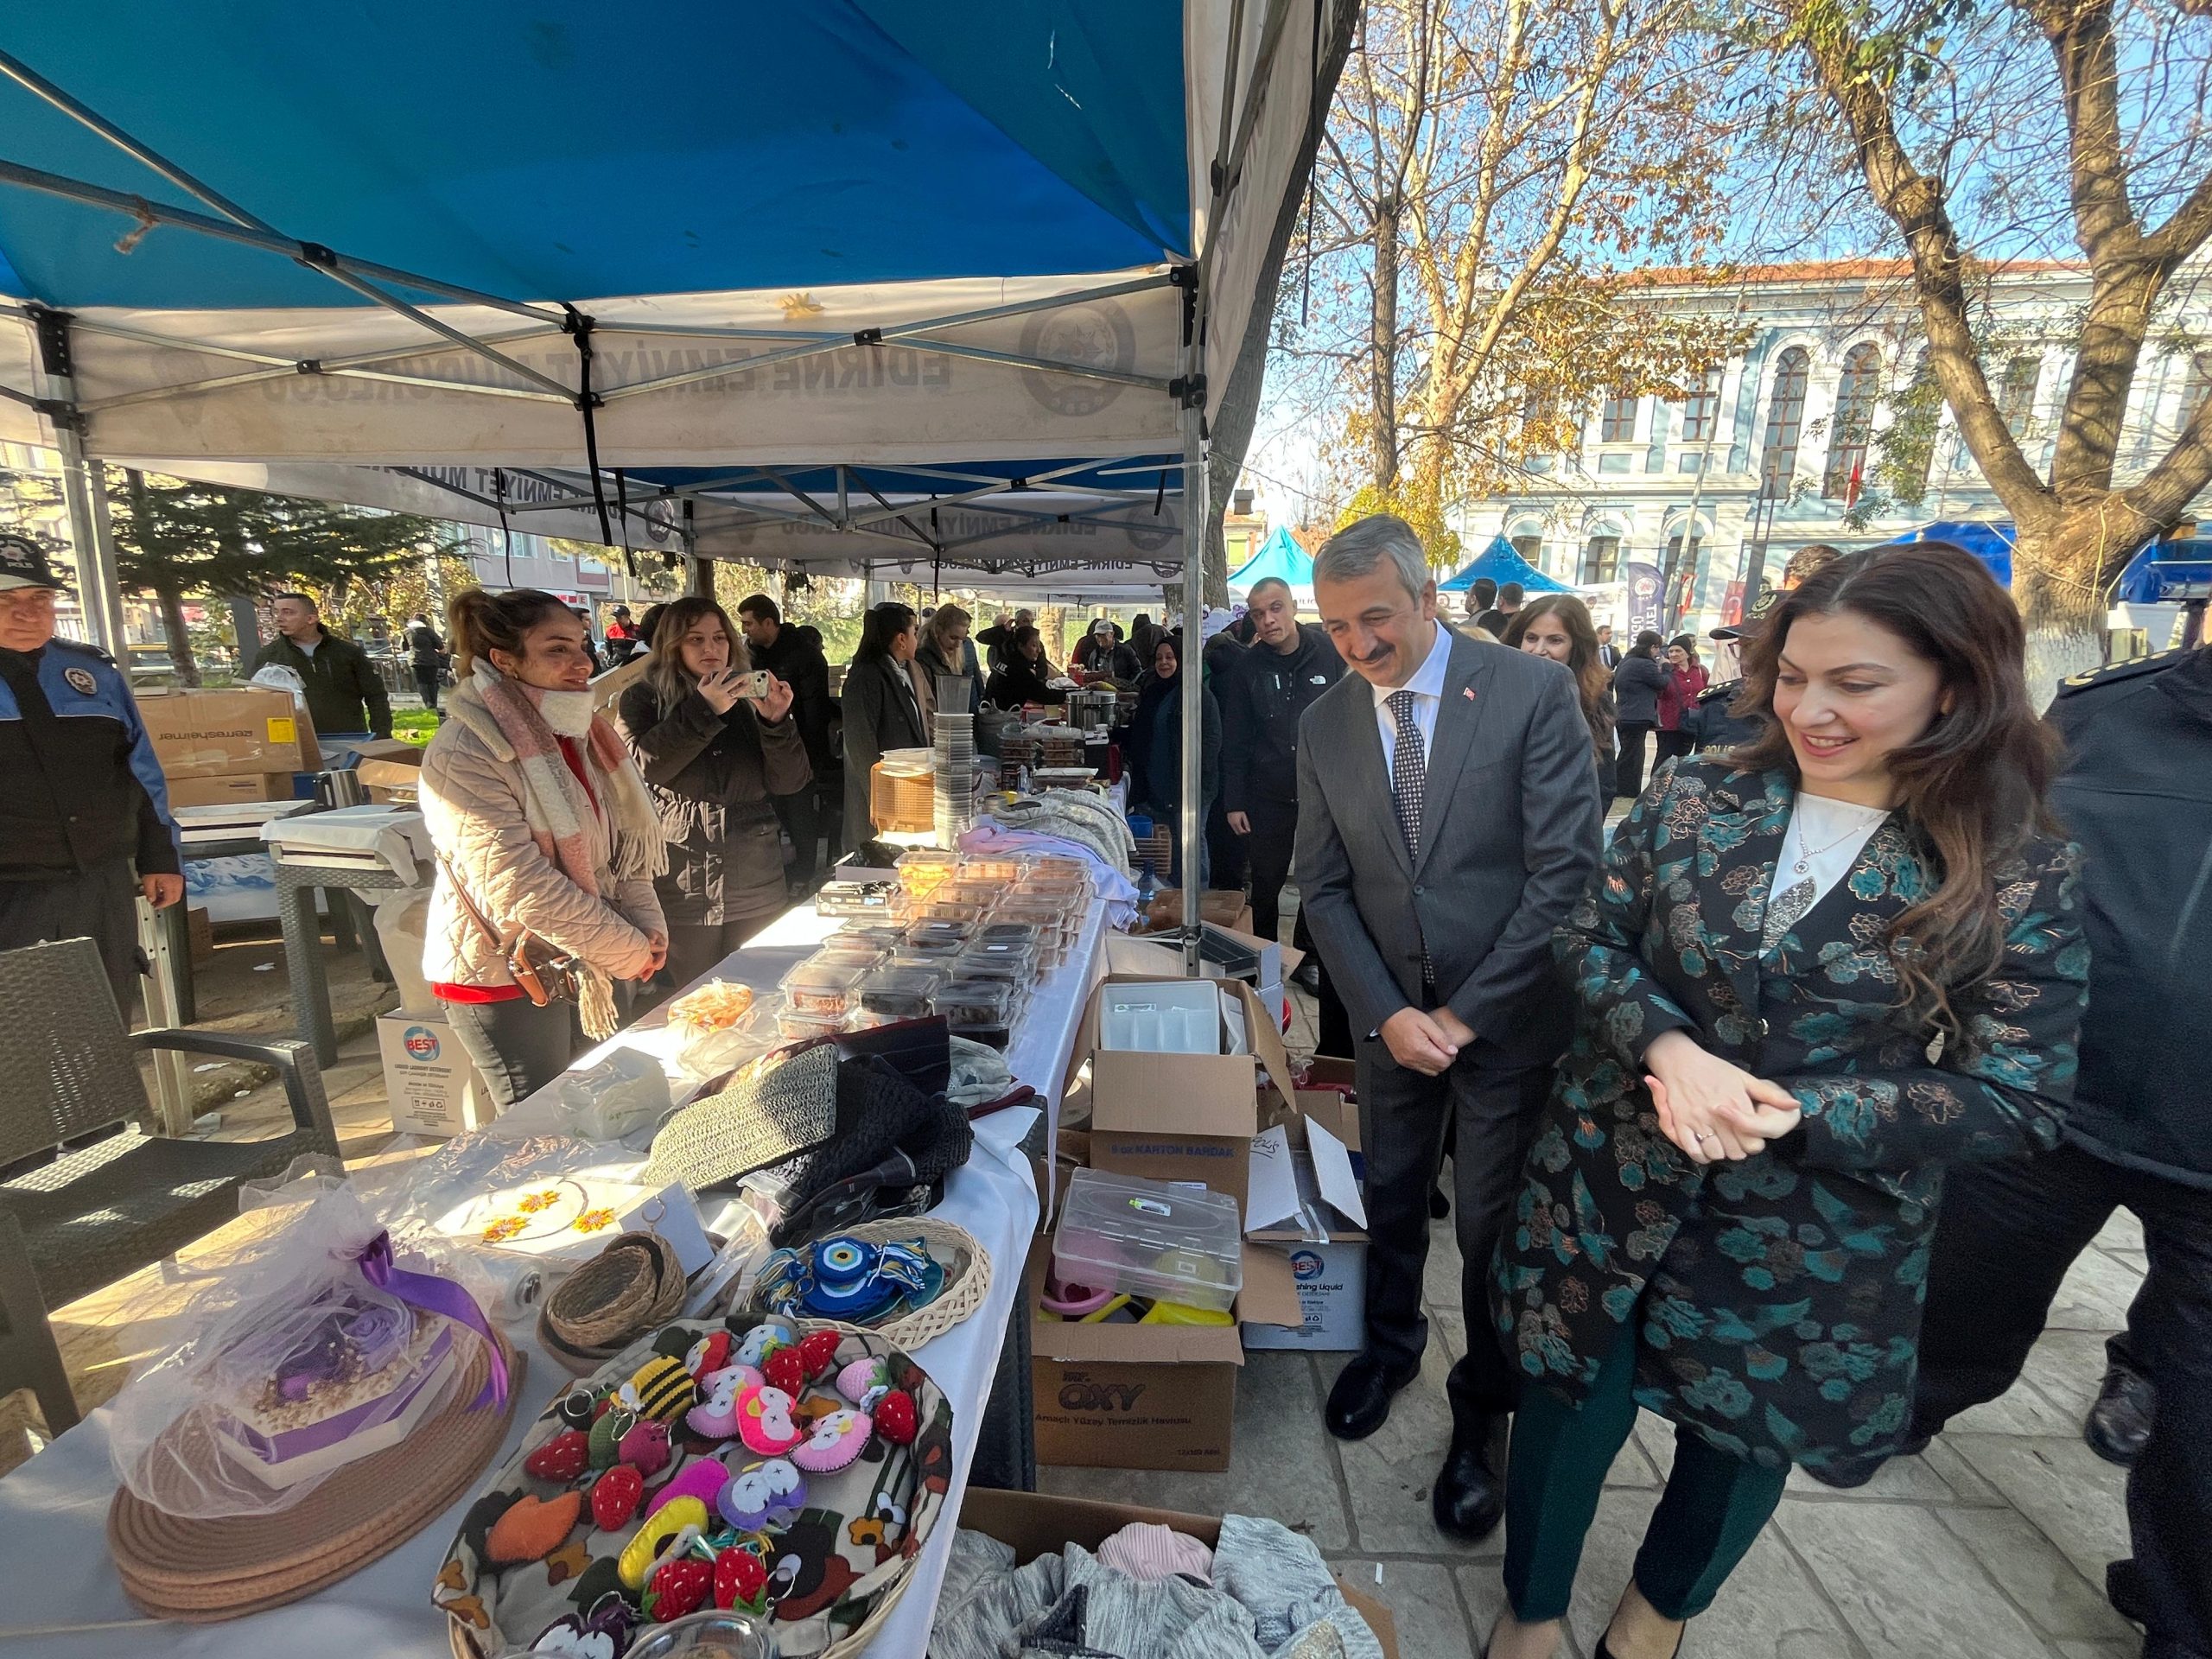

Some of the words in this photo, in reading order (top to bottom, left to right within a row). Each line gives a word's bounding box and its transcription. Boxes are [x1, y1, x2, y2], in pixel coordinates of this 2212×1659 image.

[406, 1039, 438, 1051] BEST
[1135, 1145, 1183, 1155] KARTON
[1186, 1146, 1236, 1157] BARDAK
[1058, 1383, 1146, 1411] OXY
